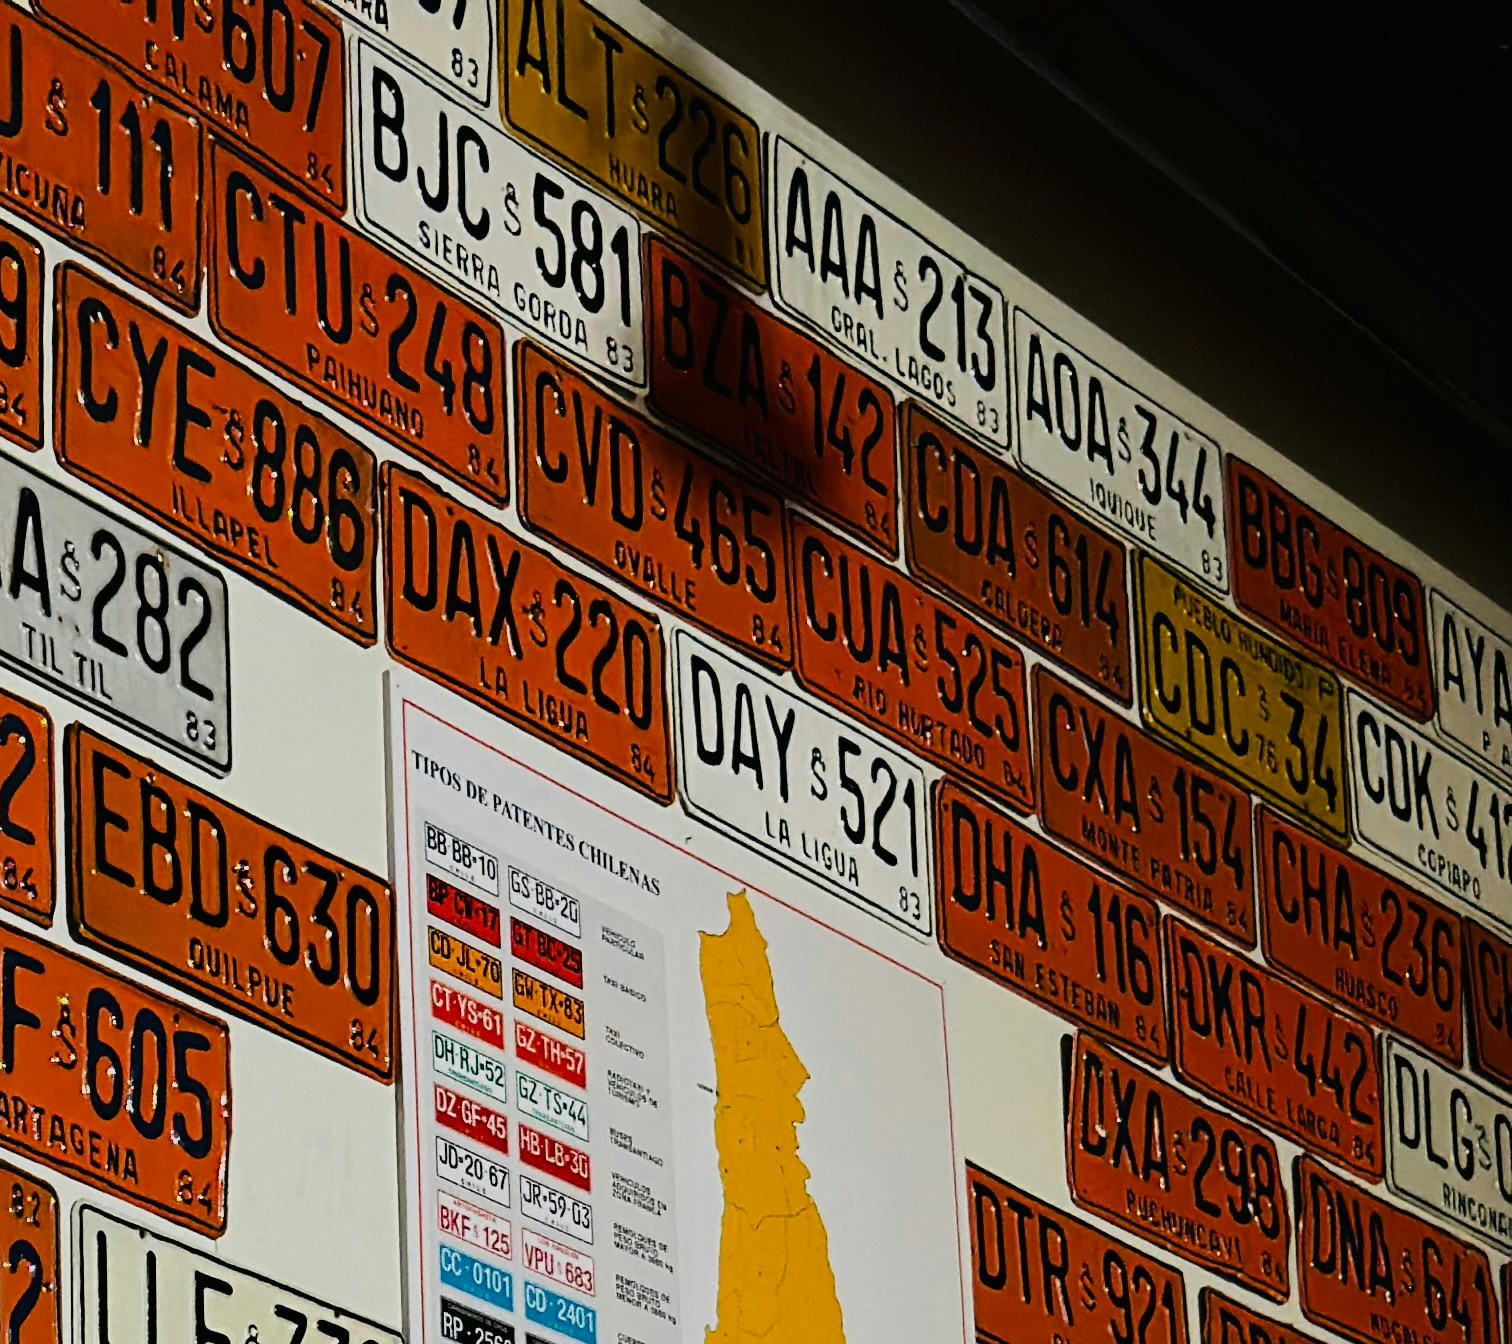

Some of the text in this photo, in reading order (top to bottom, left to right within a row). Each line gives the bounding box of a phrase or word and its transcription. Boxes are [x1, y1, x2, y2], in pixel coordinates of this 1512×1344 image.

[144, 41, 251, 137] CALAMA
[418, 222, 635, 372] SIERRA GORDA 83
[305, 344, 426, 441] PAIHUANO
[895, 350, 956, 407] LAGOS
[171, 480, 277, 569] ILLAPEL
[1090, 478, 1157, 542] IQUIQUE
[24, 622, 111, 699] TIL TIL
[412, 750, 660, 896] TIPOS DE PATENTES CHILENAS
[989, 938, 1119, 1029] SAN ESTEBAN
